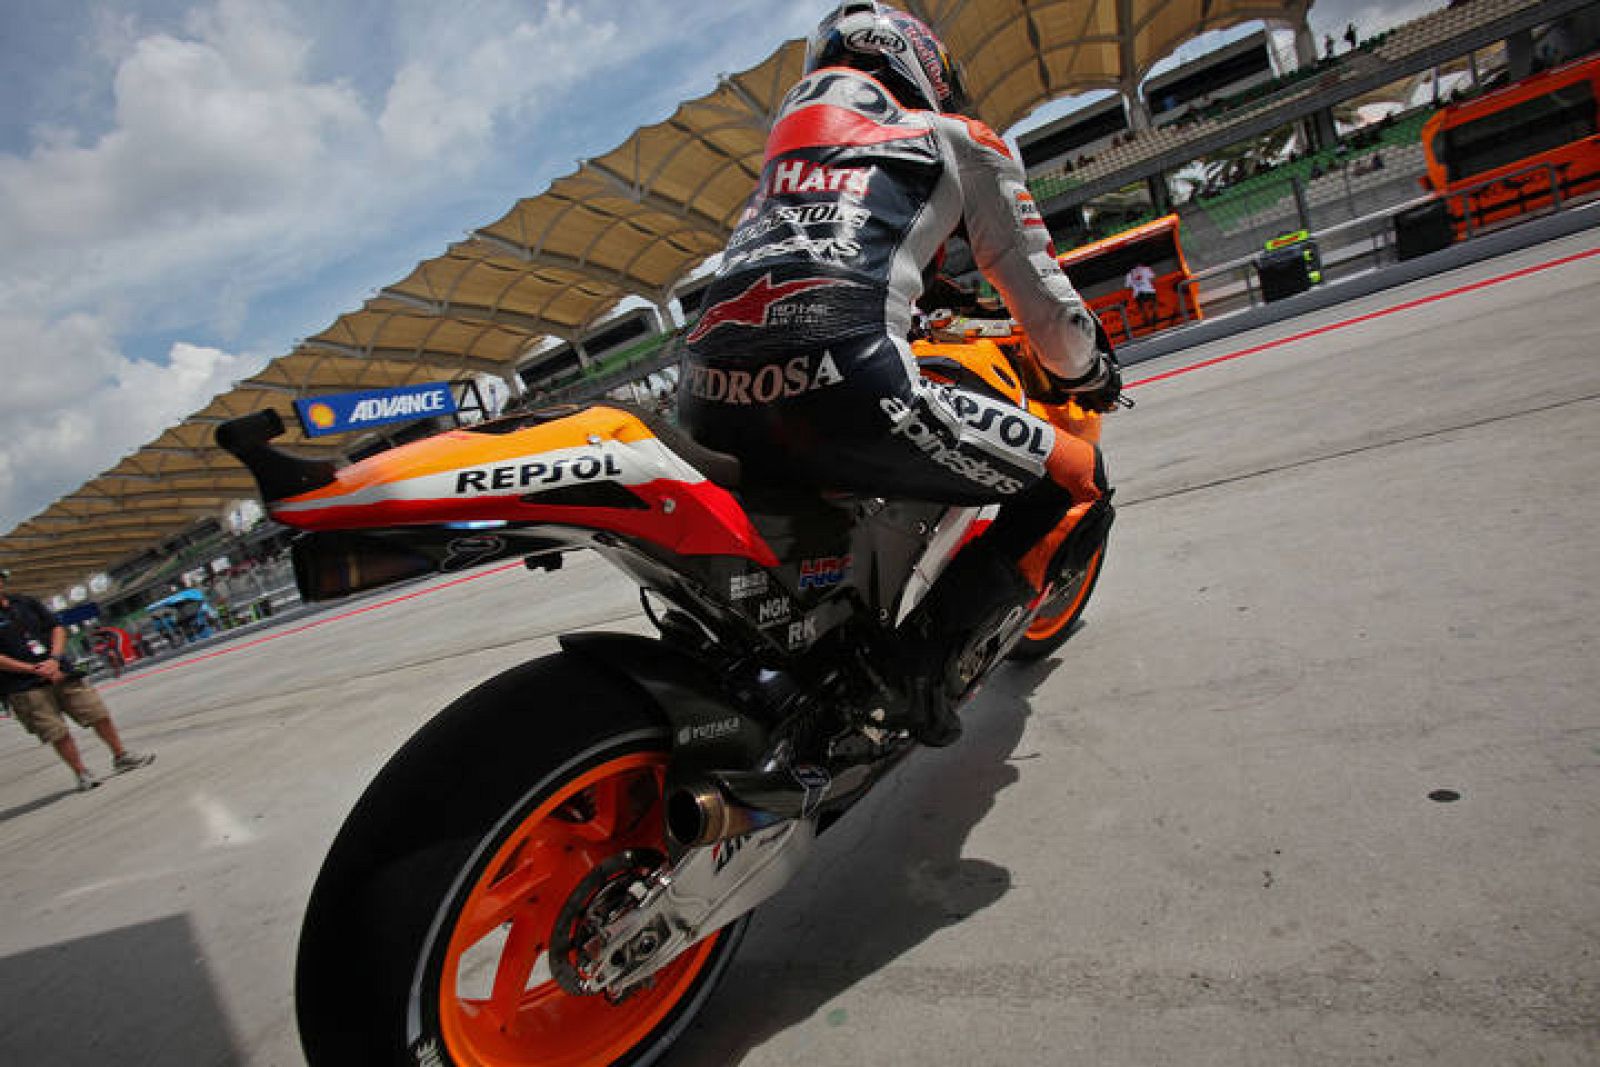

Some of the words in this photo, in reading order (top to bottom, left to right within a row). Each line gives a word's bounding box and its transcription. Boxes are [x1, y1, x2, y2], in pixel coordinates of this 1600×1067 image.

[688, 349, 846, 405] EDROSA
[348, 389, 446, 425] ADVANCE
[920, 377, 1048, 457] PSOL
[455, 453, 622, 494] REPSOL
